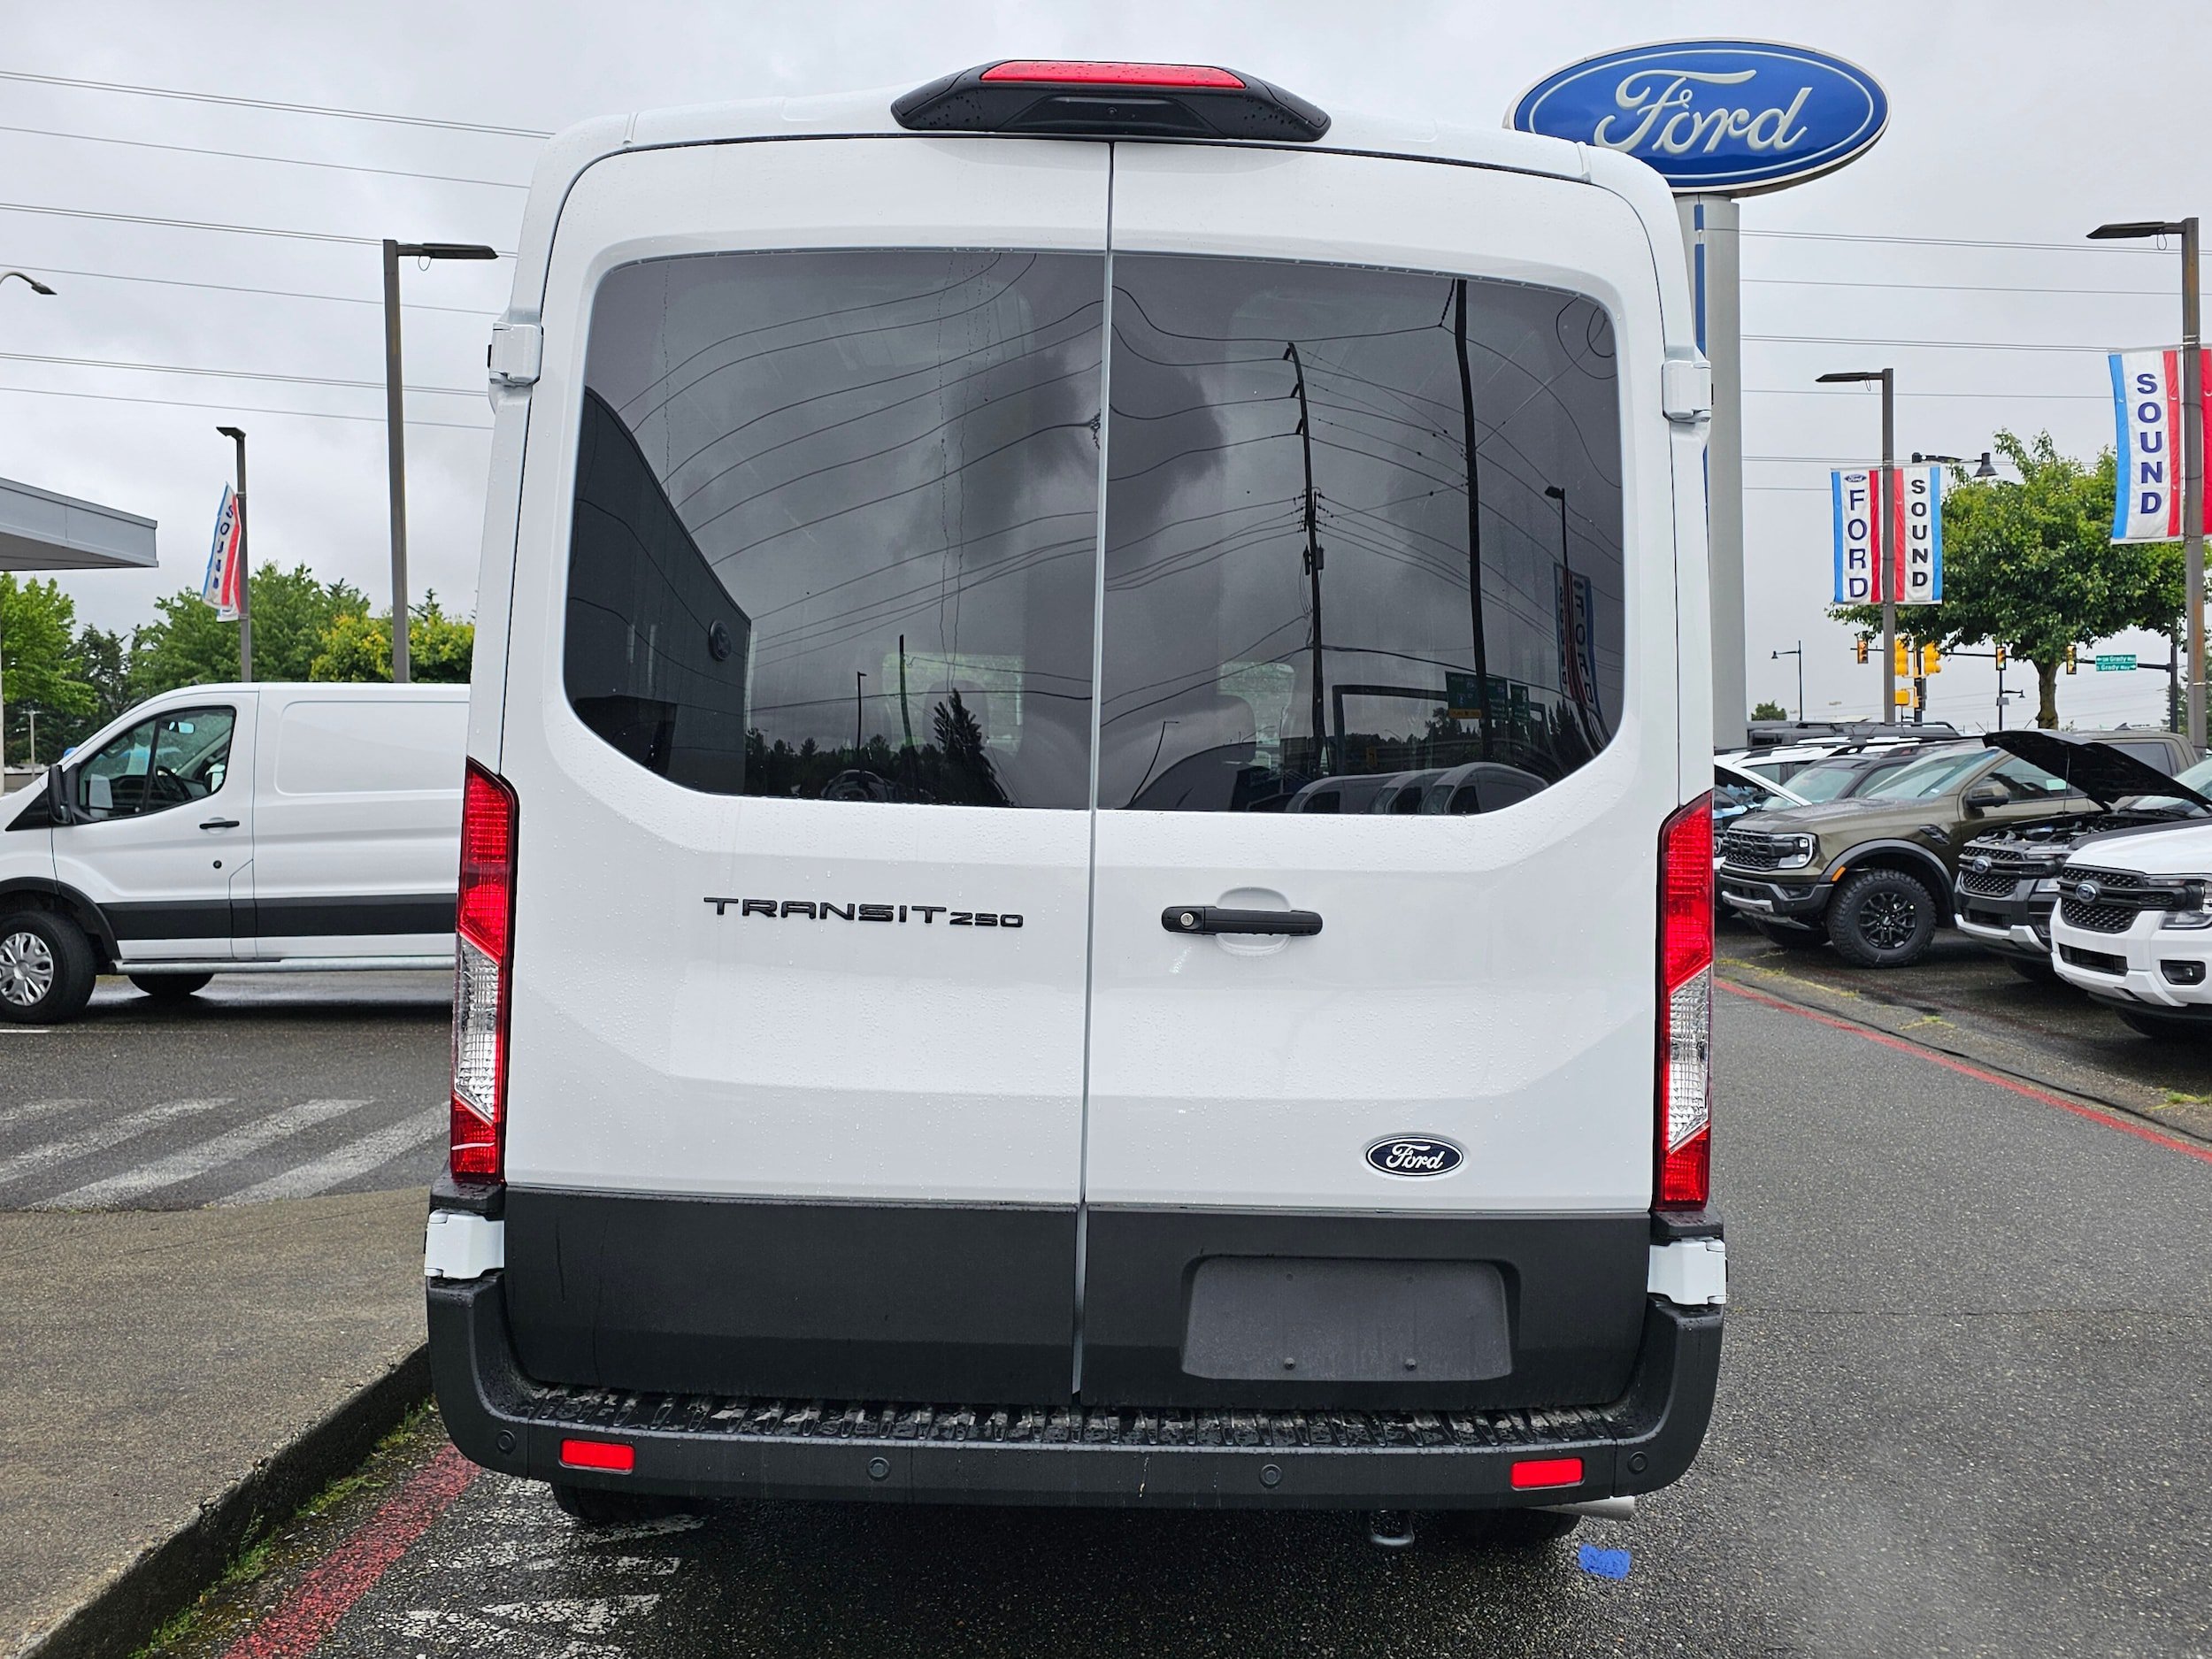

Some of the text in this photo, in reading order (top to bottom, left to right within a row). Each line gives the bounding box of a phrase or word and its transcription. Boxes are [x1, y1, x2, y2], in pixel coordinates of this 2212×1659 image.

[1594, 69, 1813, 153] Ford
[2136, 373, 2162, 514] SOUND
[1847, 489, 1868, 598] FORD
[1910, 479, 1928, 588] SOUND
[704, 897, 1024, 927] TRANSIT 250
[1386, 1143, 1445, 1169] Ford
